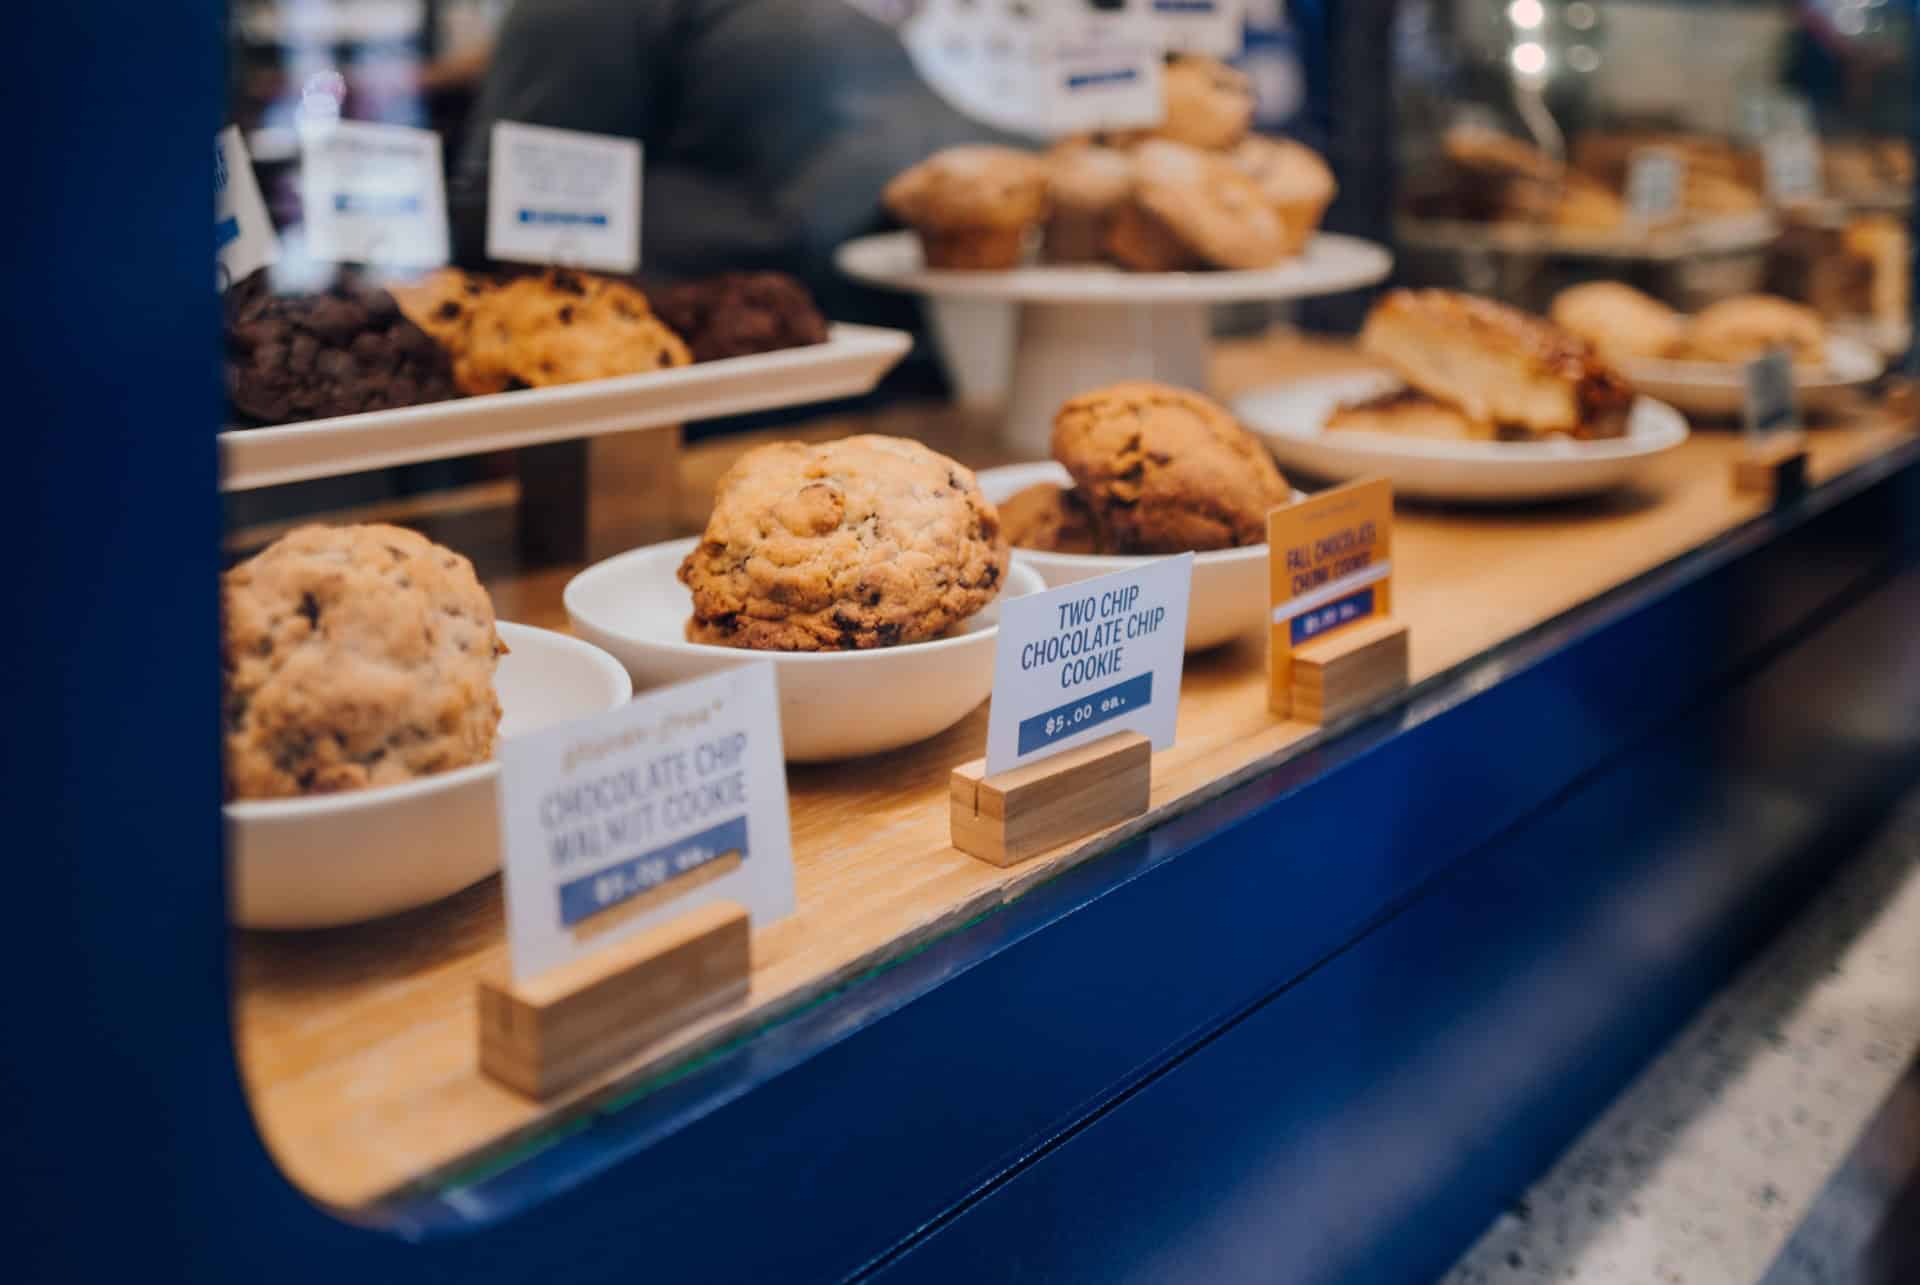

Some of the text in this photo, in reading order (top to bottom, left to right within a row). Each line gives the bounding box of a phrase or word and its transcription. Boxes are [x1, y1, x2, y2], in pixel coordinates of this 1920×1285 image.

[1058, 584, 1139, 630] TWO CHIP
[1021, 606, 1164, 671] CHOCOLATE CHIP
[1061, 647, 1123, 688] COOKIE
[1045, 695, 1126, 736] $5.00 ea.
[540, 731, 748, 829] CHOCOLATE CHIP
[550, 769, 748, 866] WALNUT COOKIE
